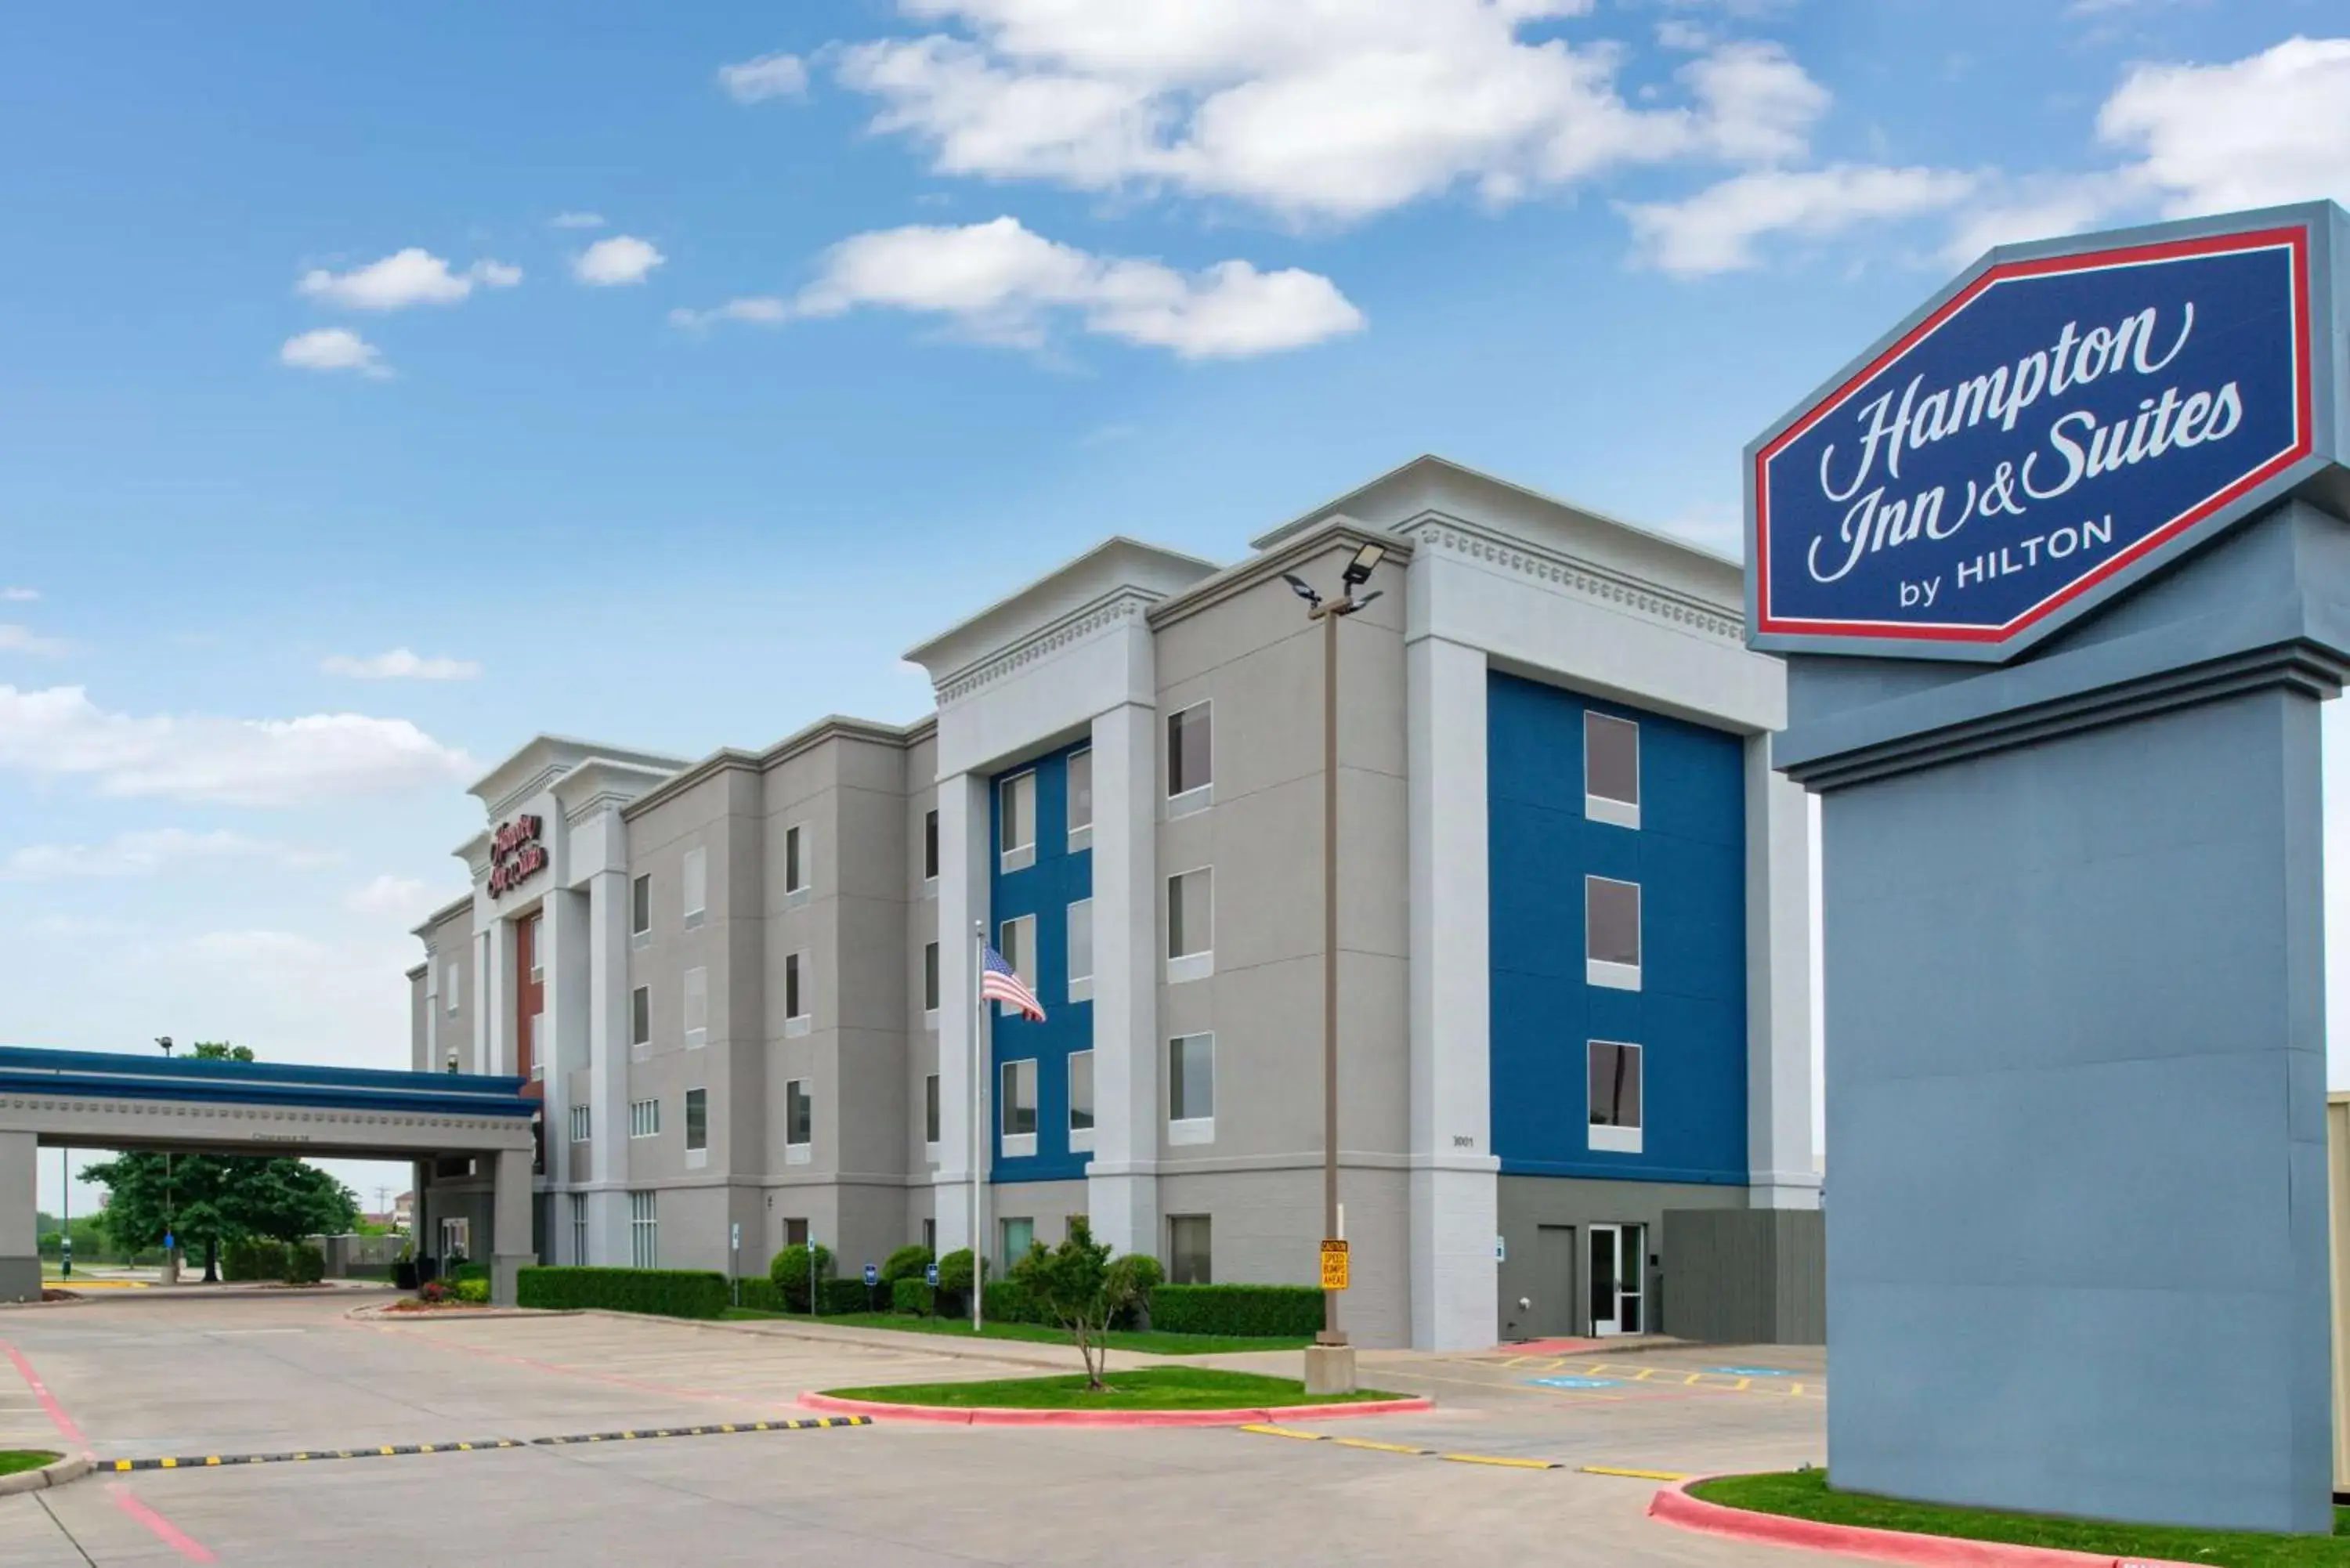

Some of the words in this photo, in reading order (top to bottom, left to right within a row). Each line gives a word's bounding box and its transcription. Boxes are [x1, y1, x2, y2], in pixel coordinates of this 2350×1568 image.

[1808, 480, 1976, 583] Inn
[1979, 461, 2026, 516] &
[2022, 381, 2243, 500] Suites
[1820, 302, 2194, 502] Hampton
[1900, 576, 1941, 607] by
[1958, 515, 2112, 588] HILTON
